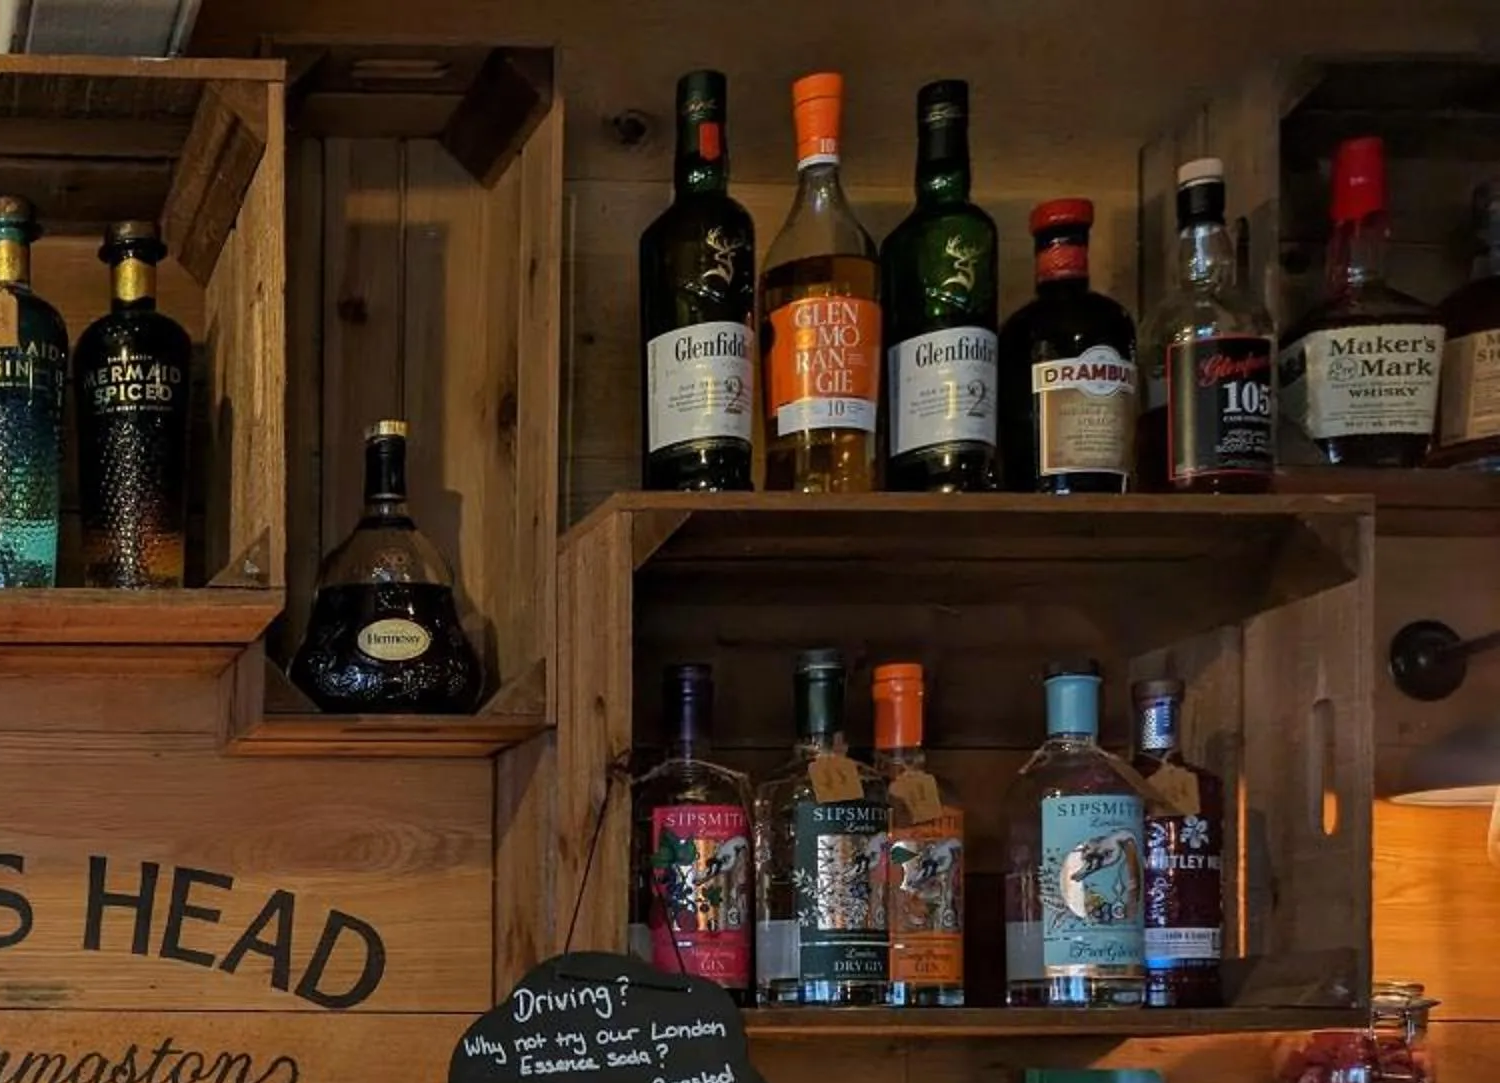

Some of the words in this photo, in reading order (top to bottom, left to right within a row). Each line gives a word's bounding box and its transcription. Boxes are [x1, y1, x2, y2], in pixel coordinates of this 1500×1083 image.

[795, 302, 859, 327] GLEN
[818, 327, 861, 348] MO
[1328, 335, 1437, 358] Maker's
[1359, 357, 1433, 378] Mark
[817, 370, 853, 393] GIE
[94, 383, 174, 404] SPICED
[1222, 381, 1271, 415] 105
[827, 400, 846, 418] 10
[82, 854, 388, 1011] HEAD
[463, 1035, 507, 1064] Why
[514, 1034, 547, 1053] not
[555, 1029, 588, 1055] try
[596, 1027, 640, 1046] our
[651, 1019, 726, 1042] London
[520, 1053, 600, 1077] Essence
